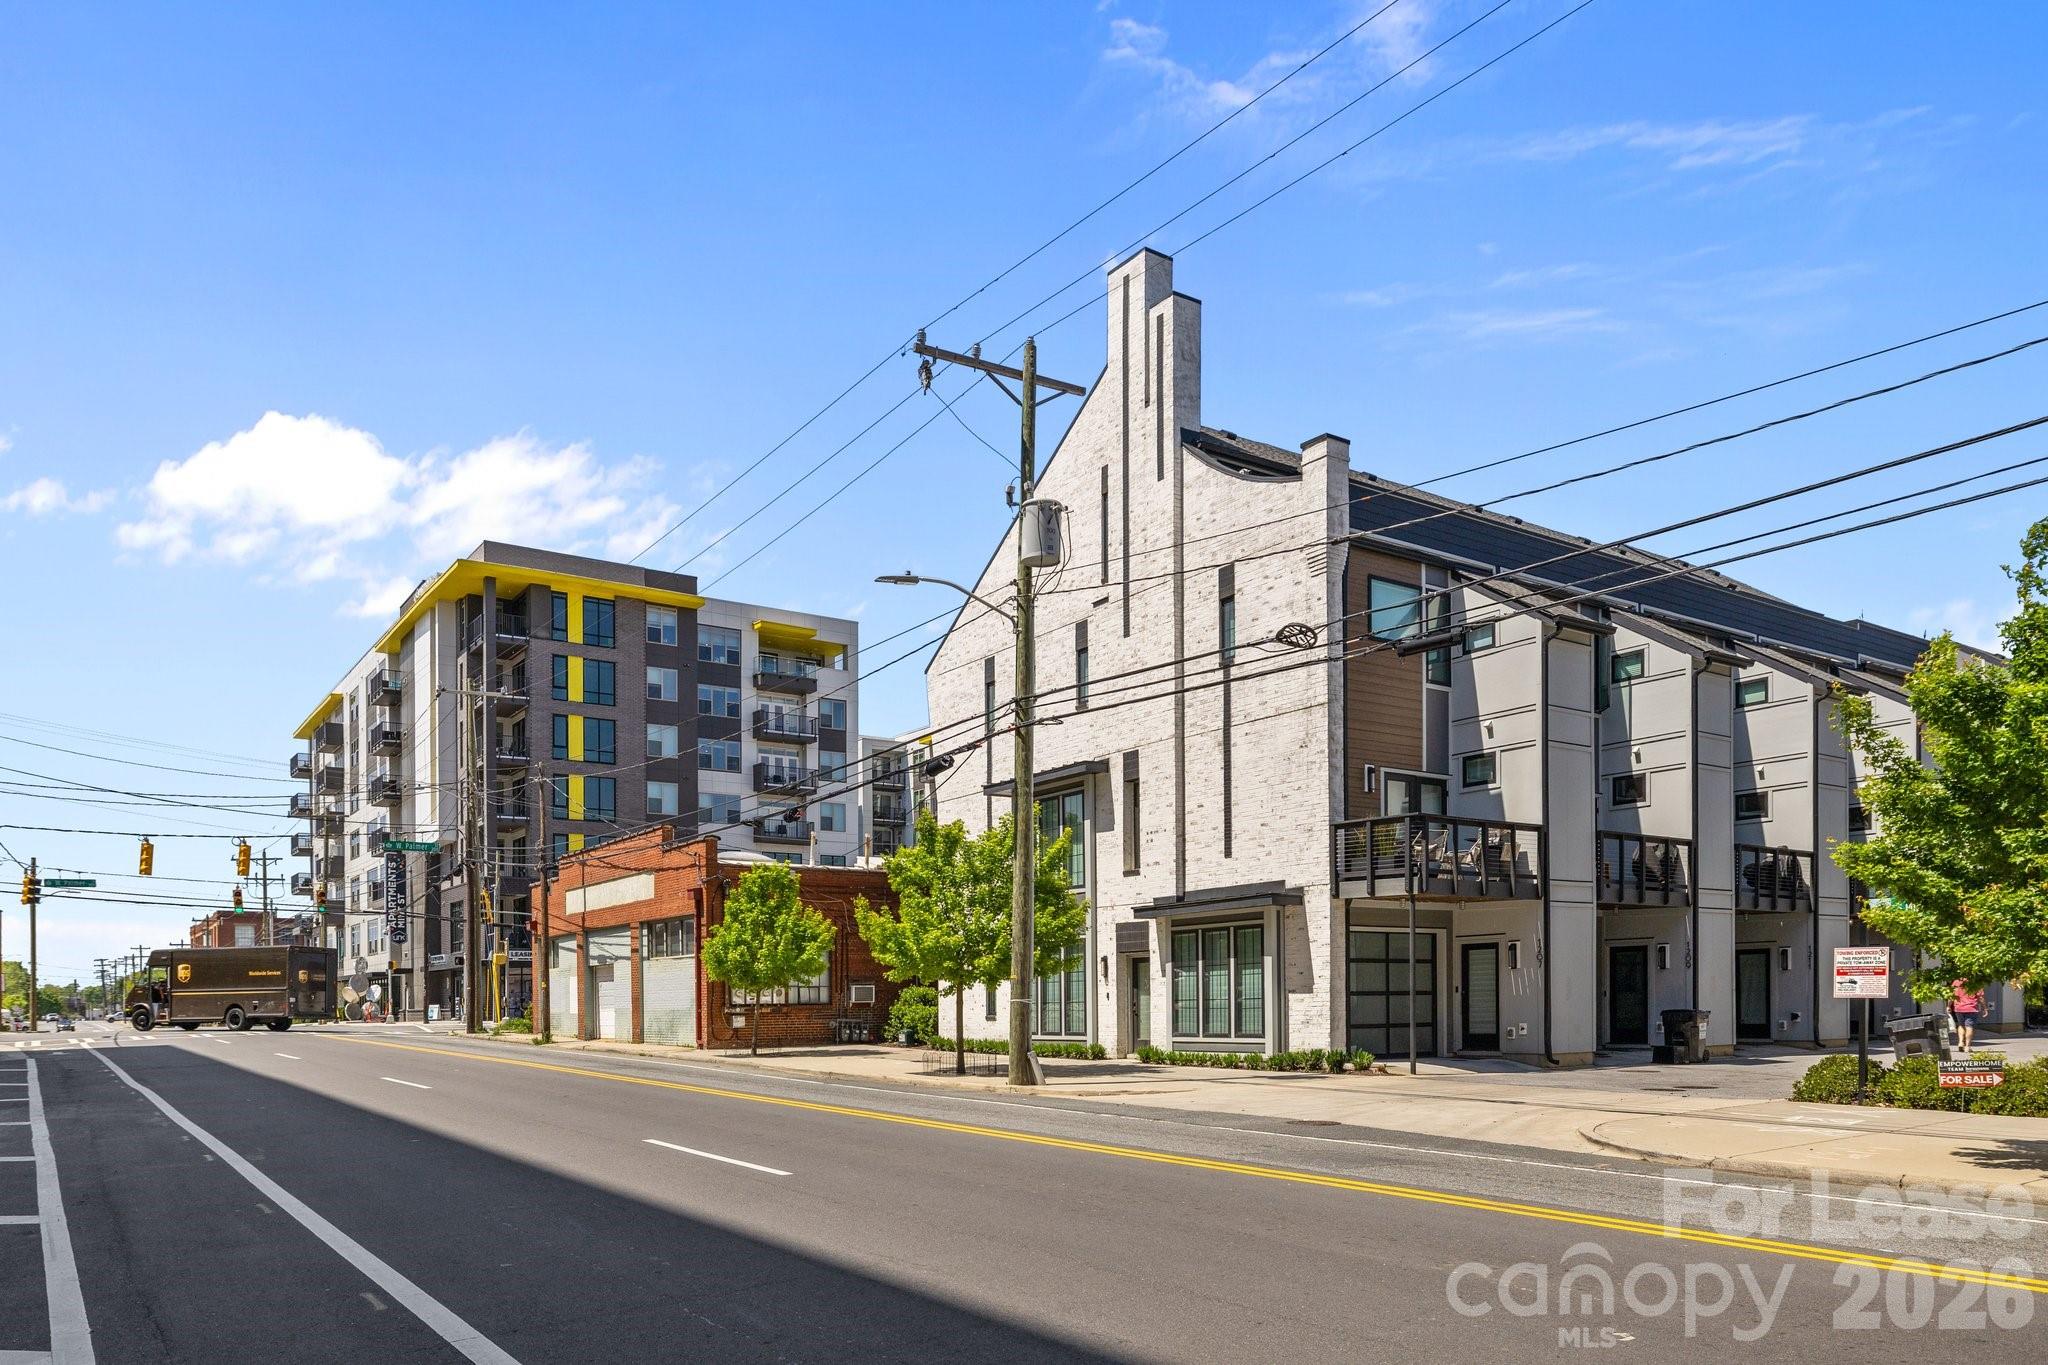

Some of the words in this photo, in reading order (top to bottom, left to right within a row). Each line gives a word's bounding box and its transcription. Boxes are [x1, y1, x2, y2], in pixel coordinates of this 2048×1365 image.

[405, 842, 428, 850] Palmer
[387, 861, 397, 928] APARTMENTS
[397, 893, 405, 904] ST
[1940, 1076, 1962, 1084] FOR
[1964, 1075, 1993, 1084] SALE
